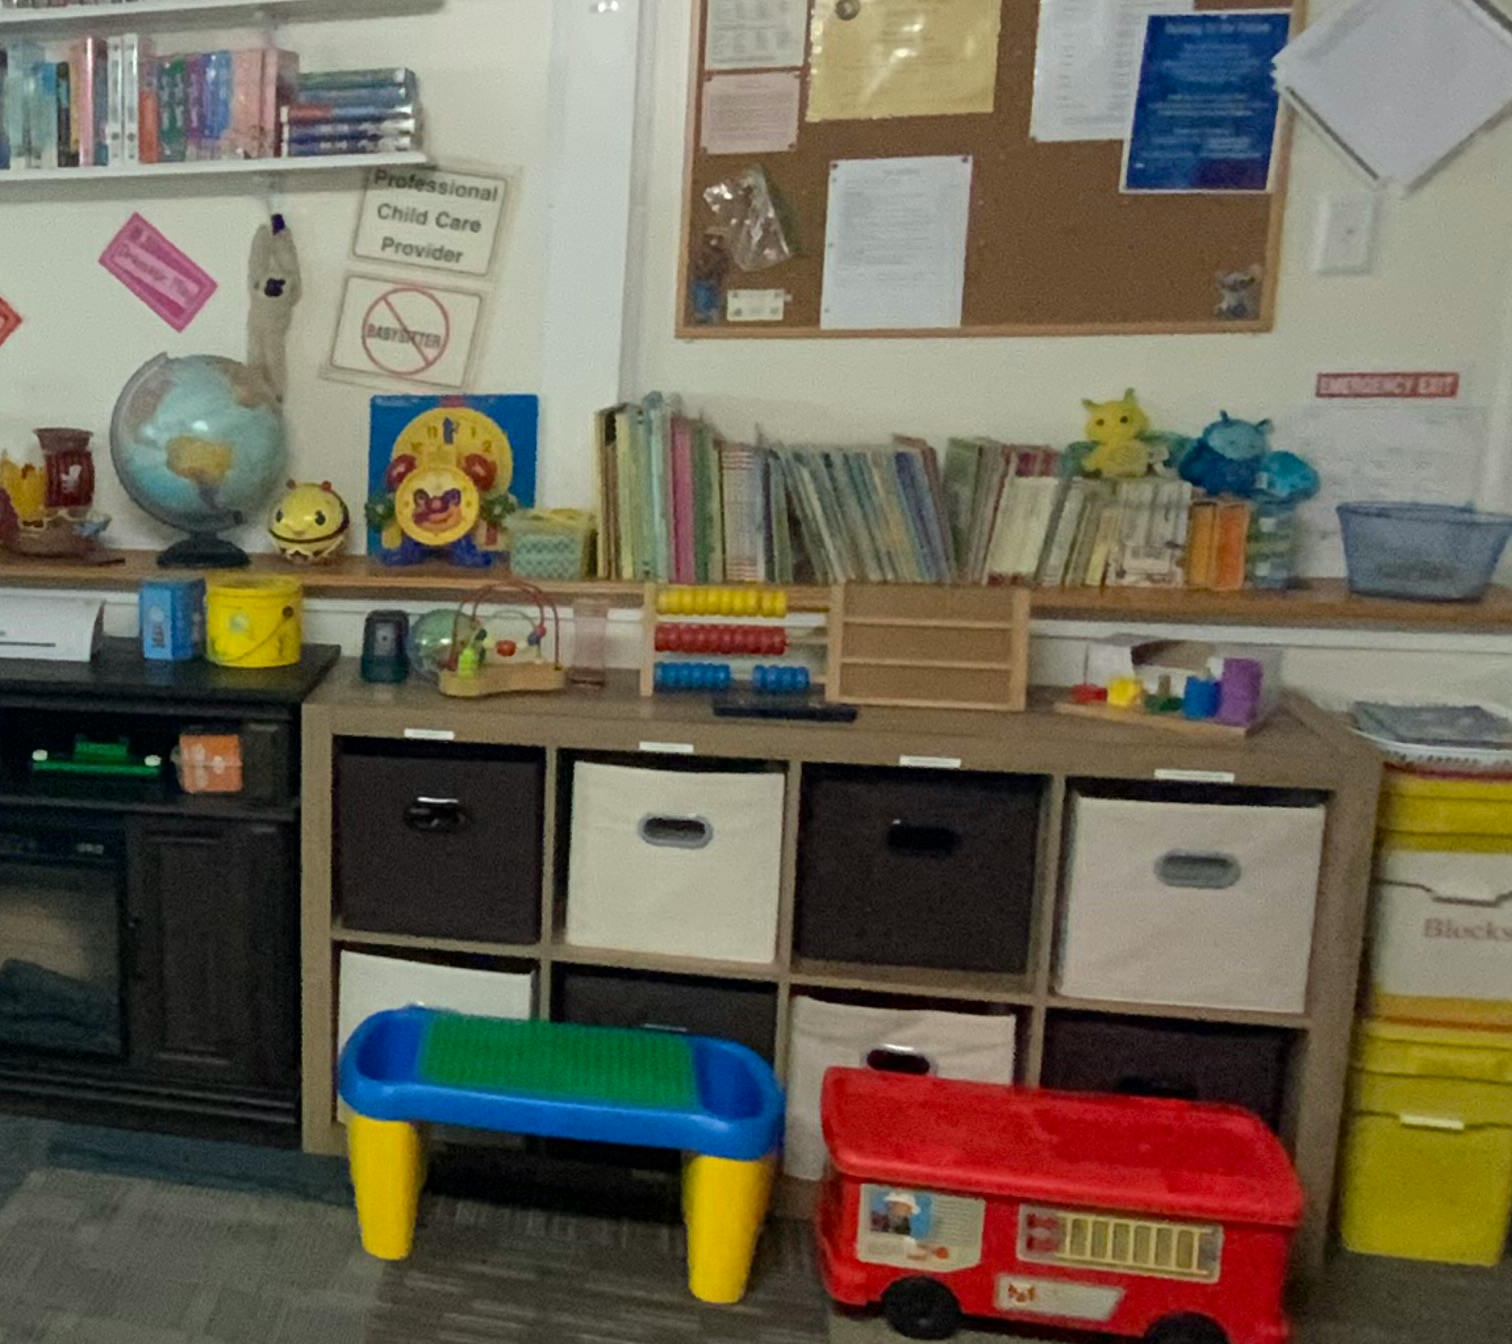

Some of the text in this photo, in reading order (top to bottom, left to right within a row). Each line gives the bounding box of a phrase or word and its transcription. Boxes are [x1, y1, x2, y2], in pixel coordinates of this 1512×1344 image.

[374, 168, 499, 202] Professional
[377, 202, 482, 234] Child Care
[380, 236, 464, 264] Provider
[366, 322, 442, 349] BABYSITTER
[1321, 375, 1455, 395] EMERGENCY EXIT
